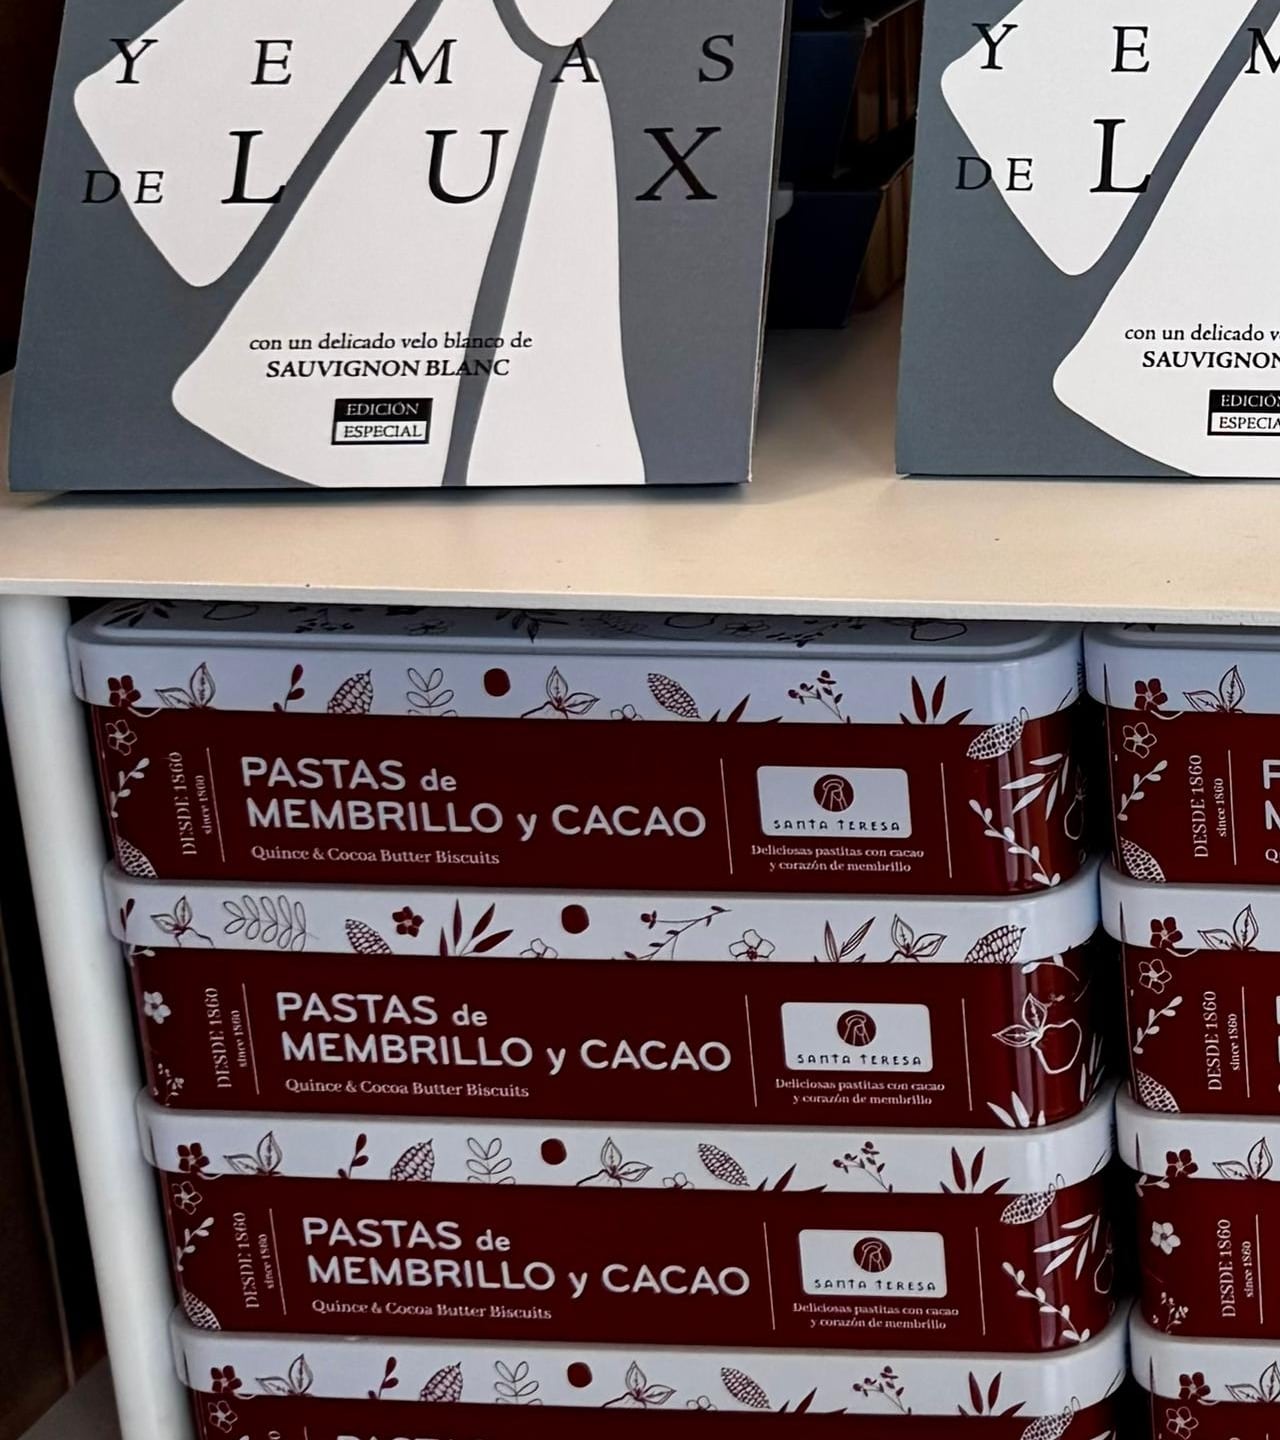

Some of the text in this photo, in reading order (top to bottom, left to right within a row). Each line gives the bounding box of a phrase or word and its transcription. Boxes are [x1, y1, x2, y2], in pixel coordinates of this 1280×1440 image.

[112, 33, 735, 85] YEMAS
[82, 126, 721, 205] DE LUX
[955, 156, 1033, 192] DE
[249, 332, 533, 351] con un delicado velo blanco de
[1125, 328, 1156, 342] con
[1162, 329, 1185, 342] un
[1190, 324, 1265, 343] delicado
[266, 358, 510, 379] SAUVIGNON BLANC
[345, 400, 421, 417] EDICIÓN
[343, 424, 422, 441] ESPECIAL
[241, 756, 457, 792] PASTAS de
[246, 797, 706, 842] MEMBRILLO y CACAO
